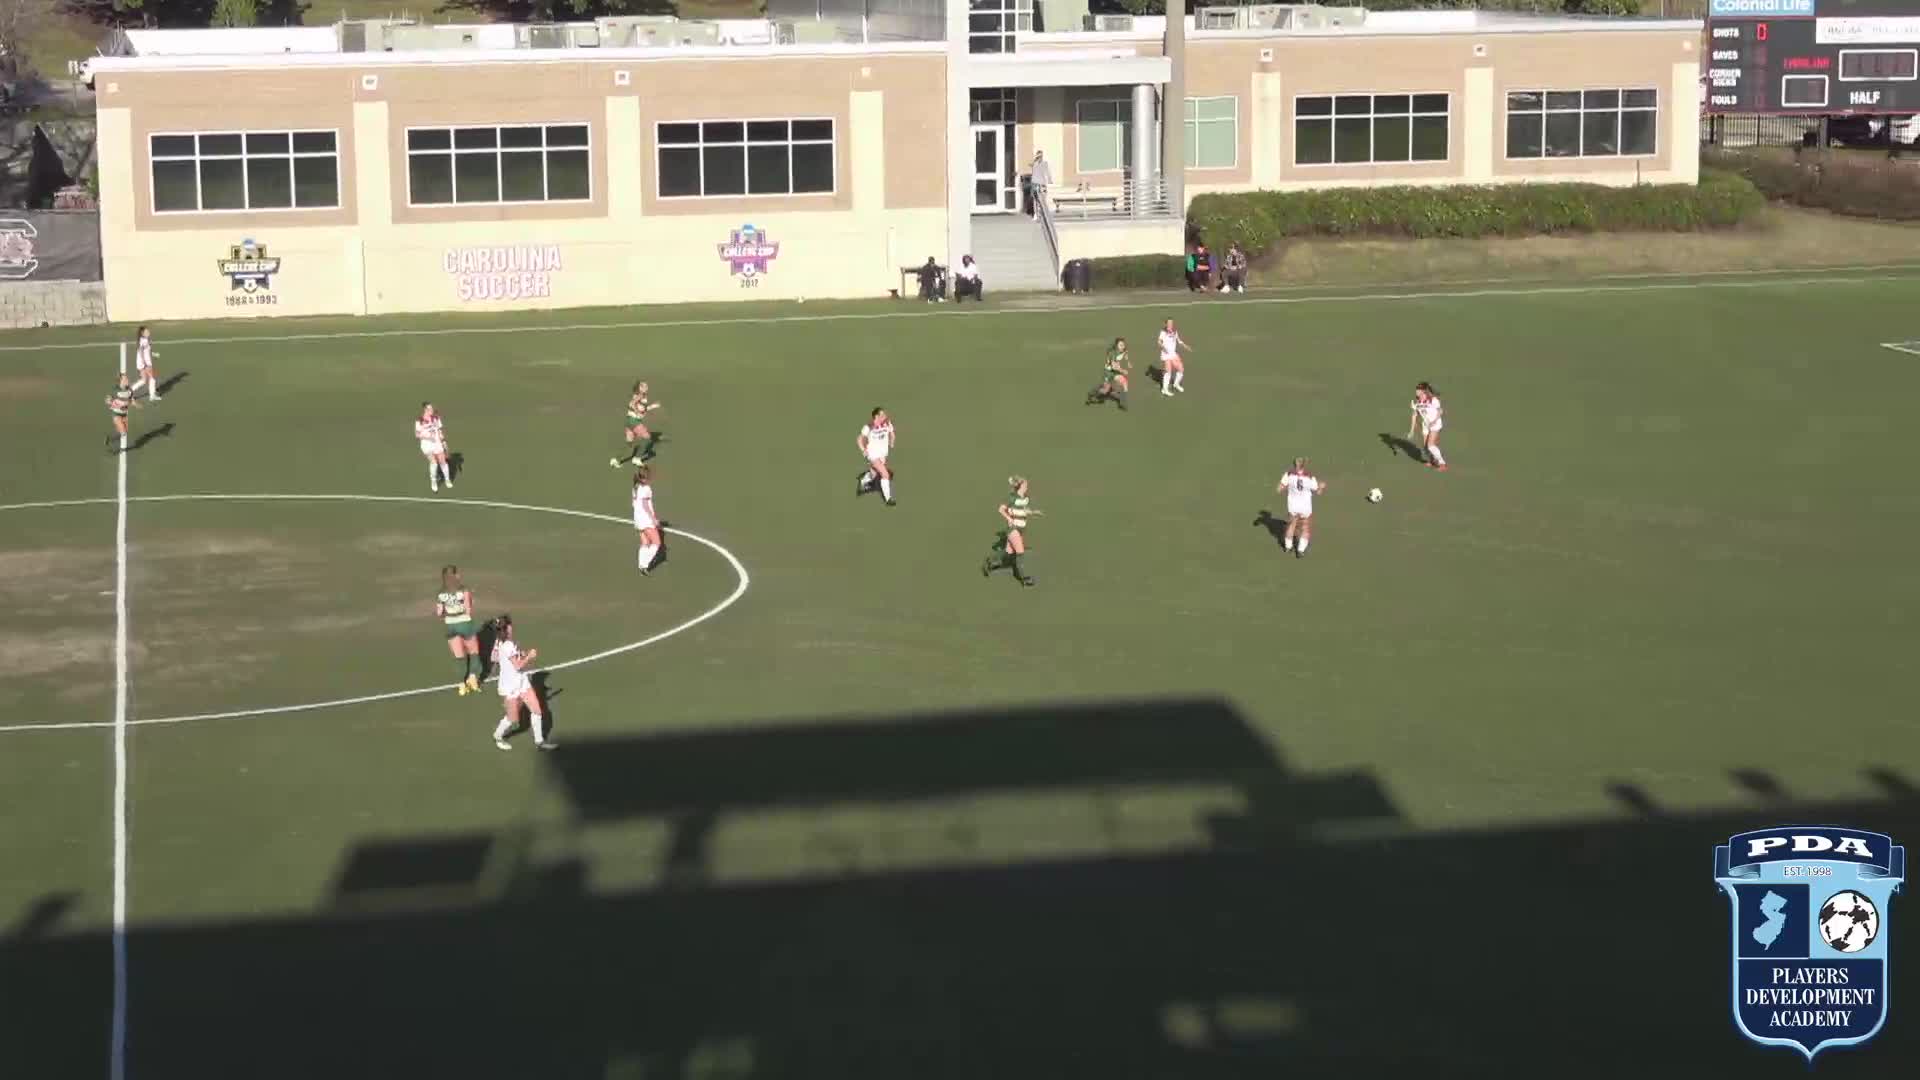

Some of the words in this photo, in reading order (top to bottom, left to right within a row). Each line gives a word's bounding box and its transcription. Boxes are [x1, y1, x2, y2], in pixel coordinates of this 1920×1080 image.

[1713, 0, 1780, 11] Colonial
[1783, 0, 1810, 10] Life
[1850, 91, 1880, 104] HALF
[442, 244, 562, 273] CAROLINA
[457, 272, 551, 300] SOCCER
